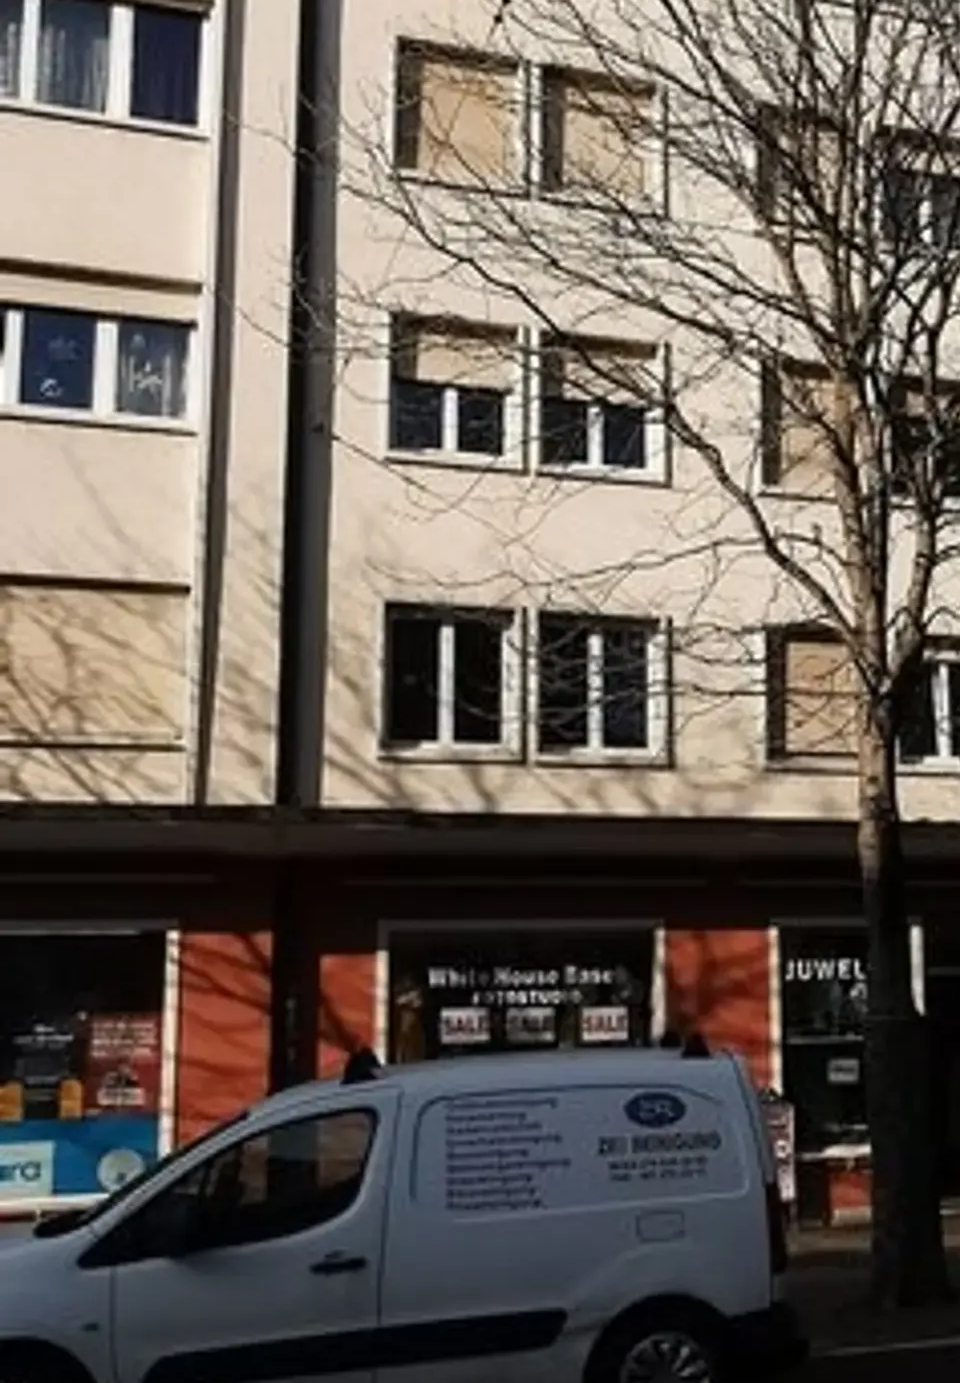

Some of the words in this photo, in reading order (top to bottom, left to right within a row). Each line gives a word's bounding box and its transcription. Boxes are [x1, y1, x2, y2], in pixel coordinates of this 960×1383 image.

[494, 967, 560, 988] House
[442, 1014, 489, 1035] SALE
[582, 1014, 628, 1034] SALE
